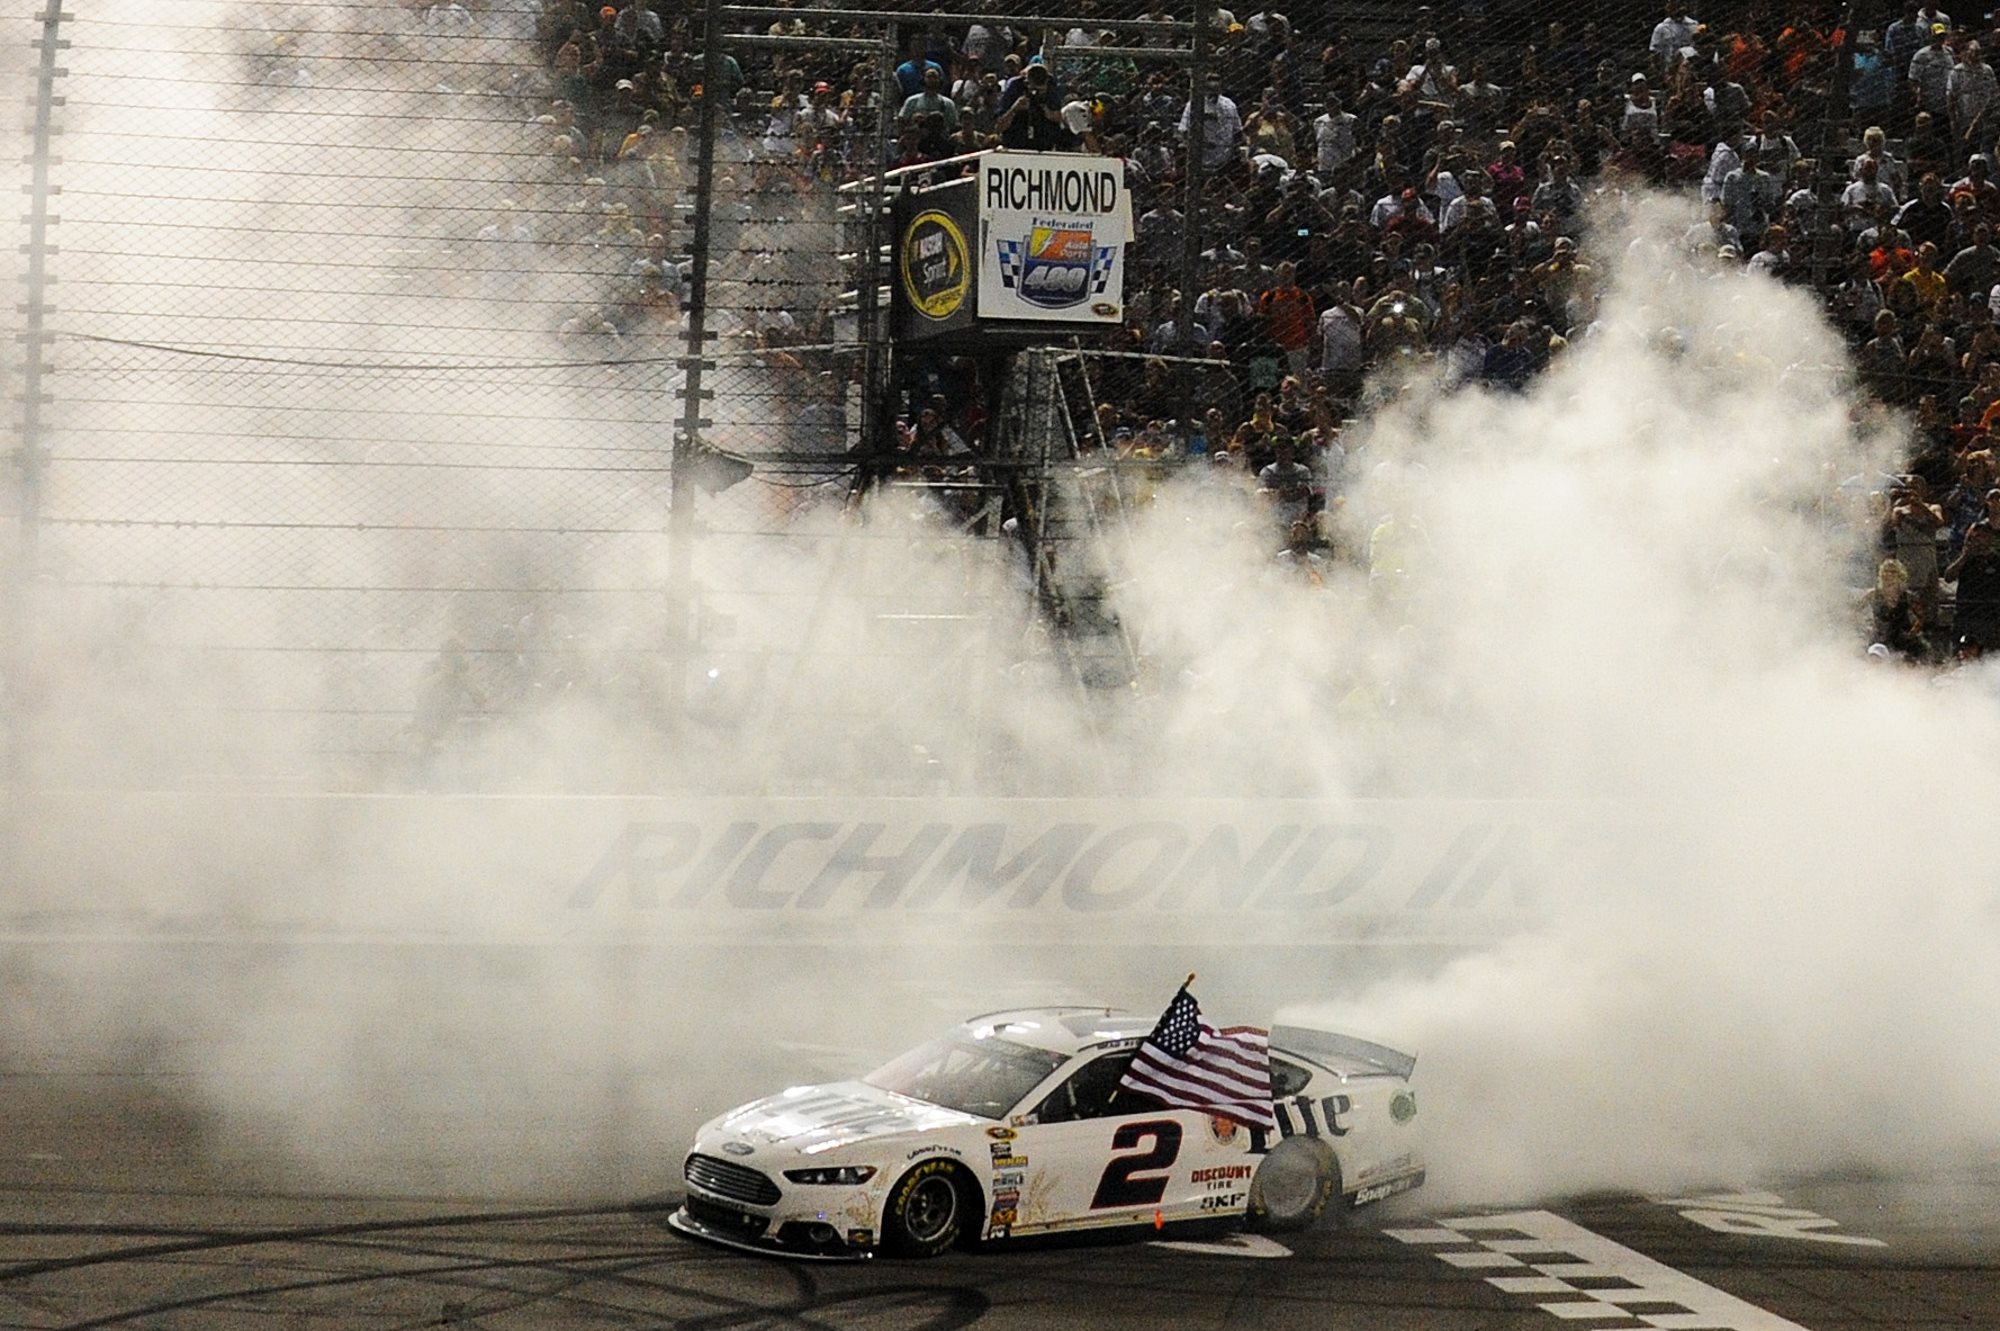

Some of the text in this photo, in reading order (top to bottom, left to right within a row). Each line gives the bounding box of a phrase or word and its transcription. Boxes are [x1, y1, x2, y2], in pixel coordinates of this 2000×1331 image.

[987, 167, 1118, 213] RICHMOND
[1032, 217, 1094, 229] Federated
[566, 819, 1391, 911] RICHMOND
[1090, 1120, 1183, 1210] 2
[1190, 1165, 1252, 1183] DISCOUNT
[1206, 1181, 1233, 1191] TIRE
[1199, 1192, 1246, 1209] SKF
